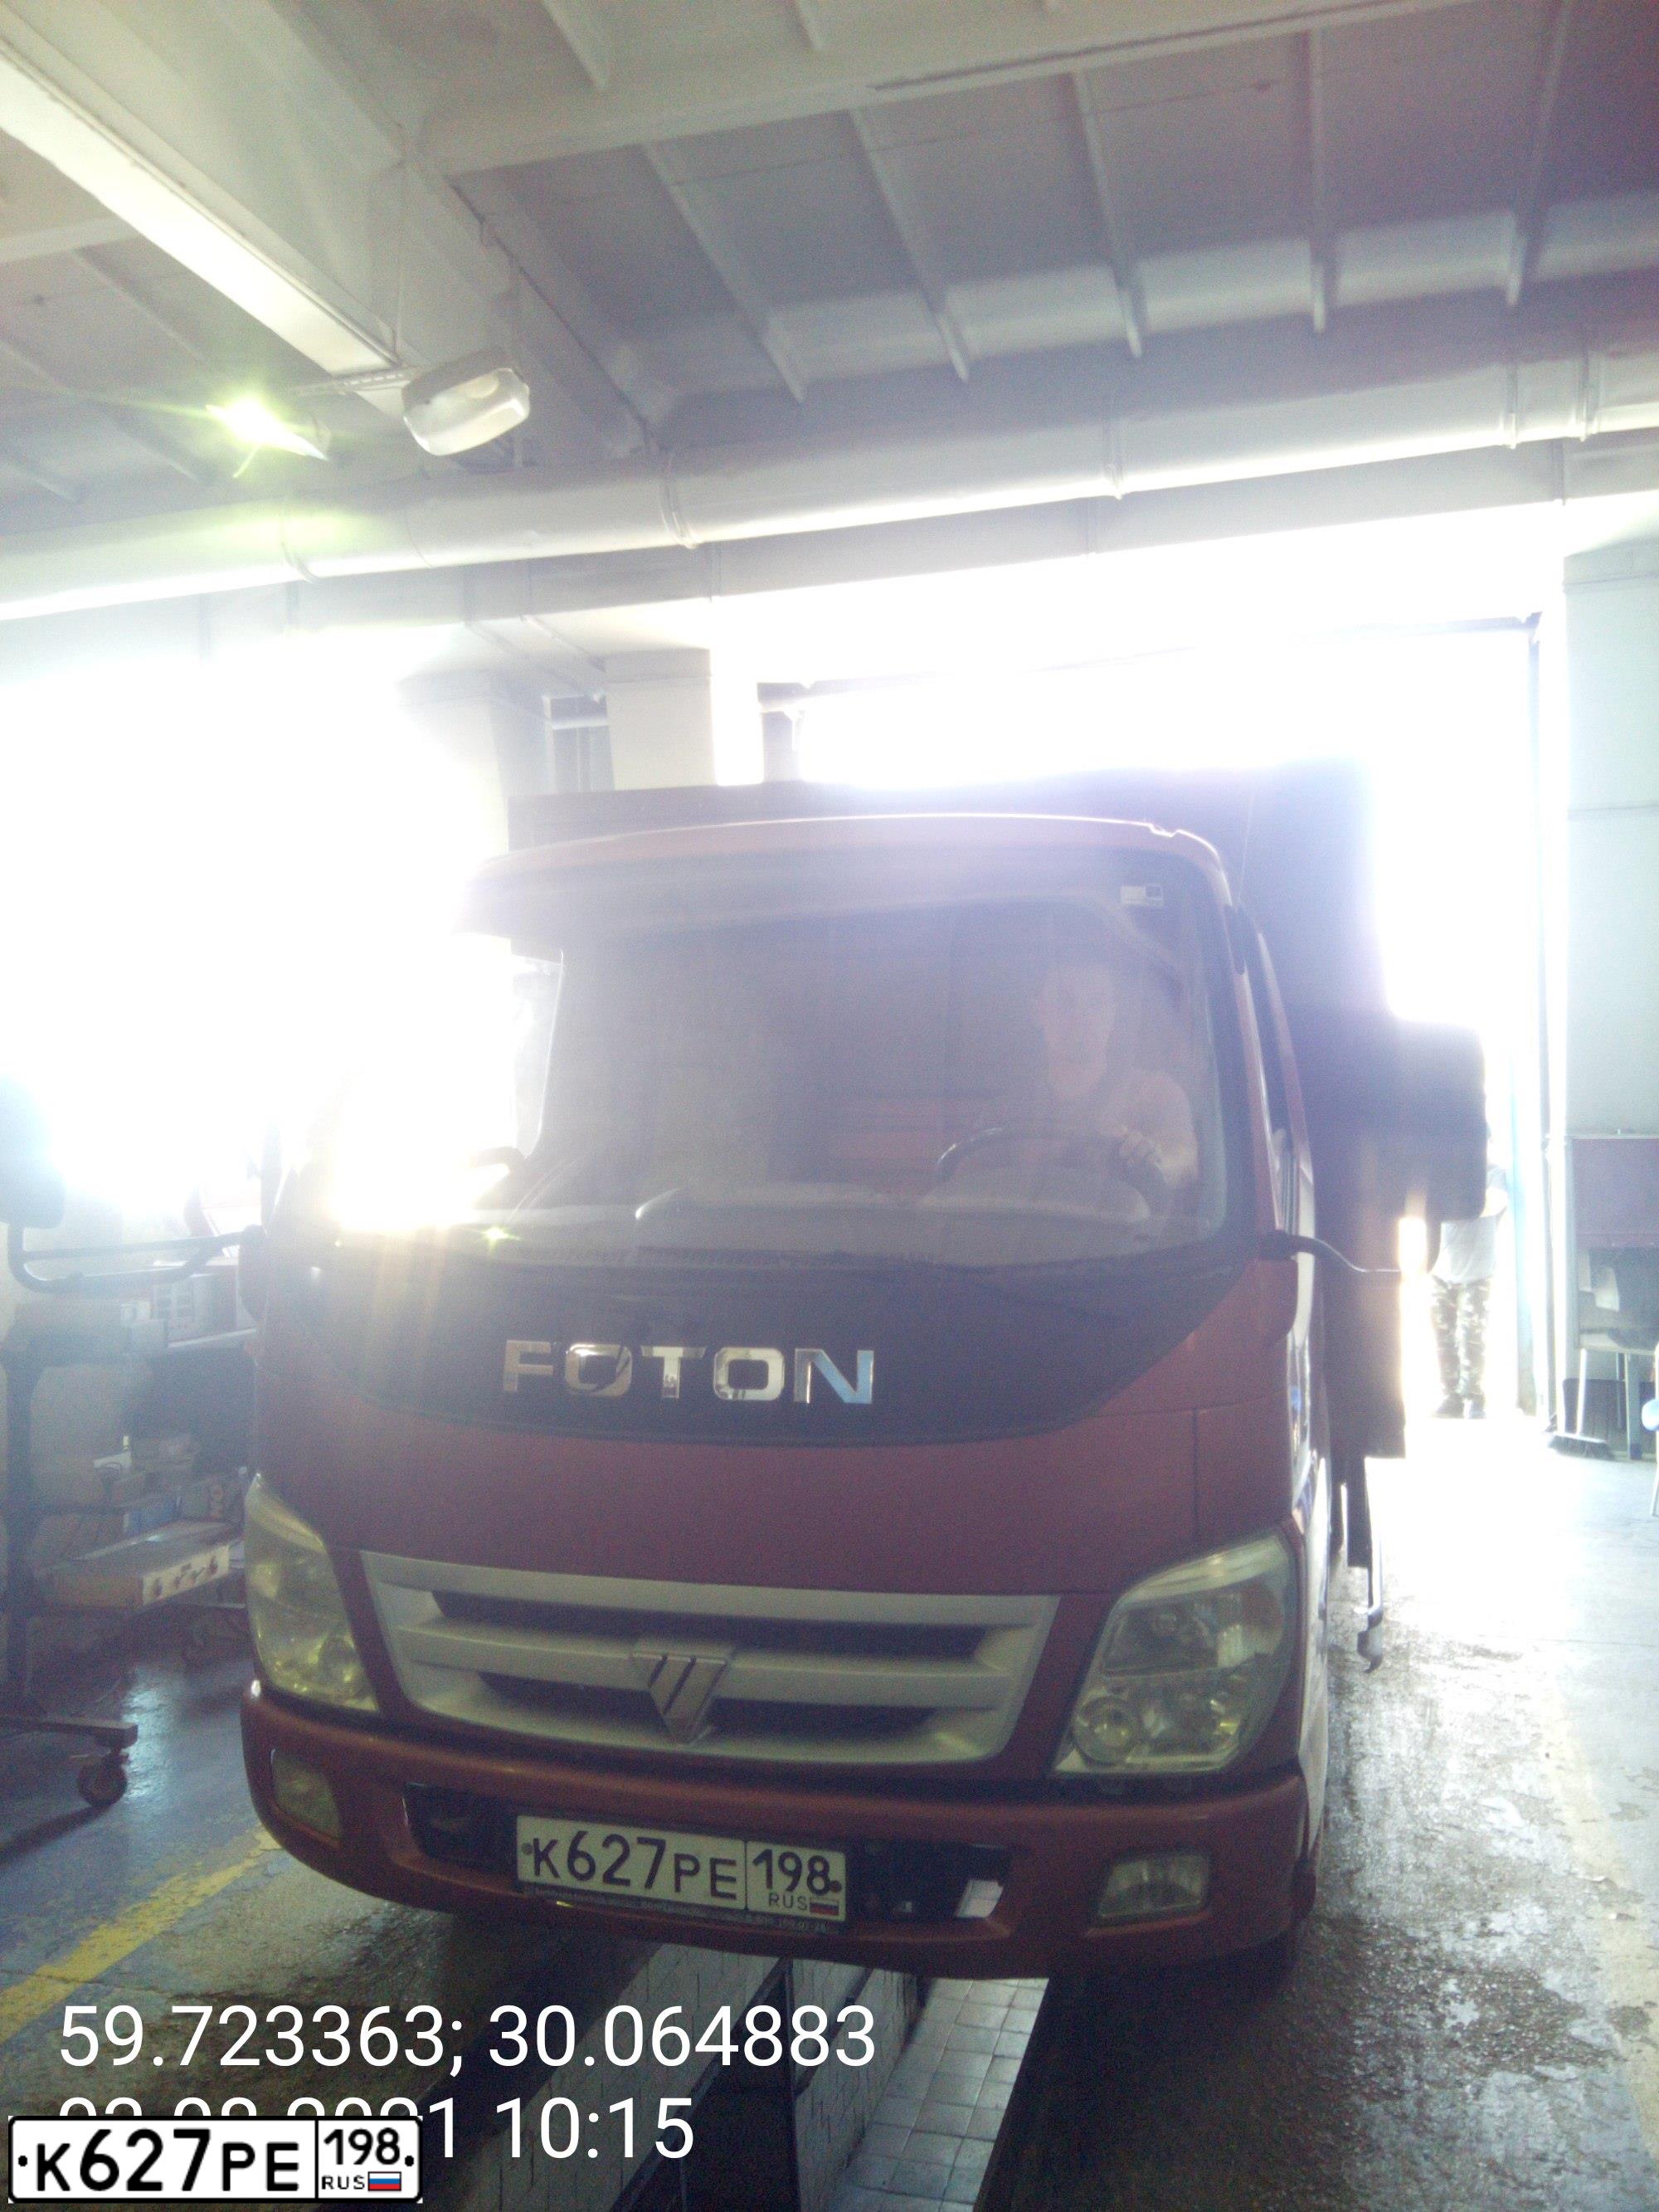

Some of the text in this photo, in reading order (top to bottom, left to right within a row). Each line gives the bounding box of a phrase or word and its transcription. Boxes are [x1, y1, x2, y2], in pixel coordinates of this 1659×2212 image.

[502, 1339, 875, 1406] FOTON
[753, 1849, 831, 1896] 198
[768, 1893, 808, 1910] RUS
